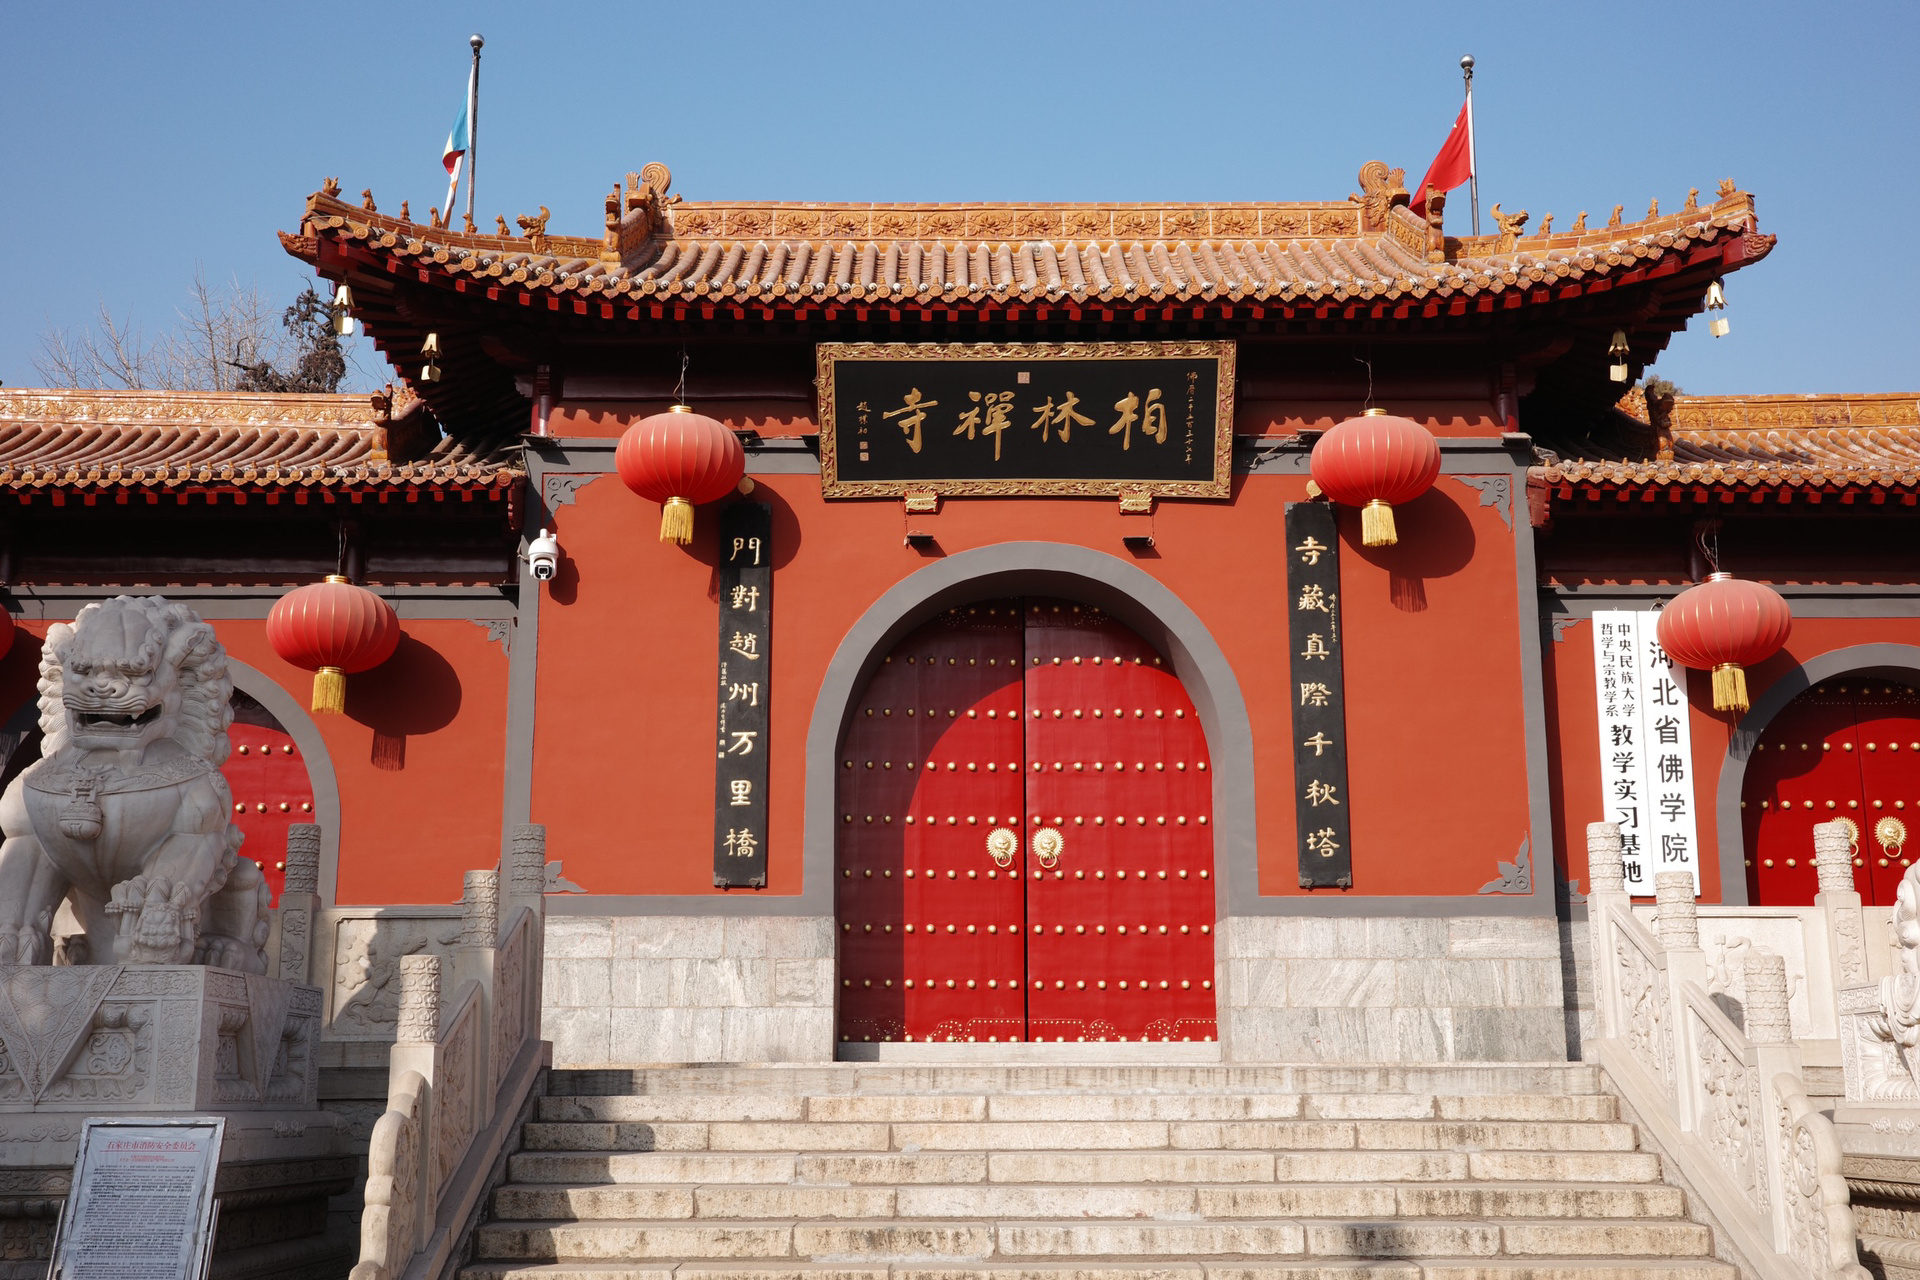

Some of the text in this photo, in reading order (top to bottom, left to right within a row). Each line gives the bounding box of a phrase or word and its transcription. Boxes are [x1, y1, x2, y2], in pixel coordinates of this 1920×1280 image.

[882, 388, 1168, 462] 柏林禪寺
[723, 537, 762, 858] 門對趙州万里橋
[1600, 623, 1619, 717] 哲学与宗教学系
[1618, 623, 1636, 717] 中央民族大学
[1610, 724, 1643, 883] 教学实习基地
